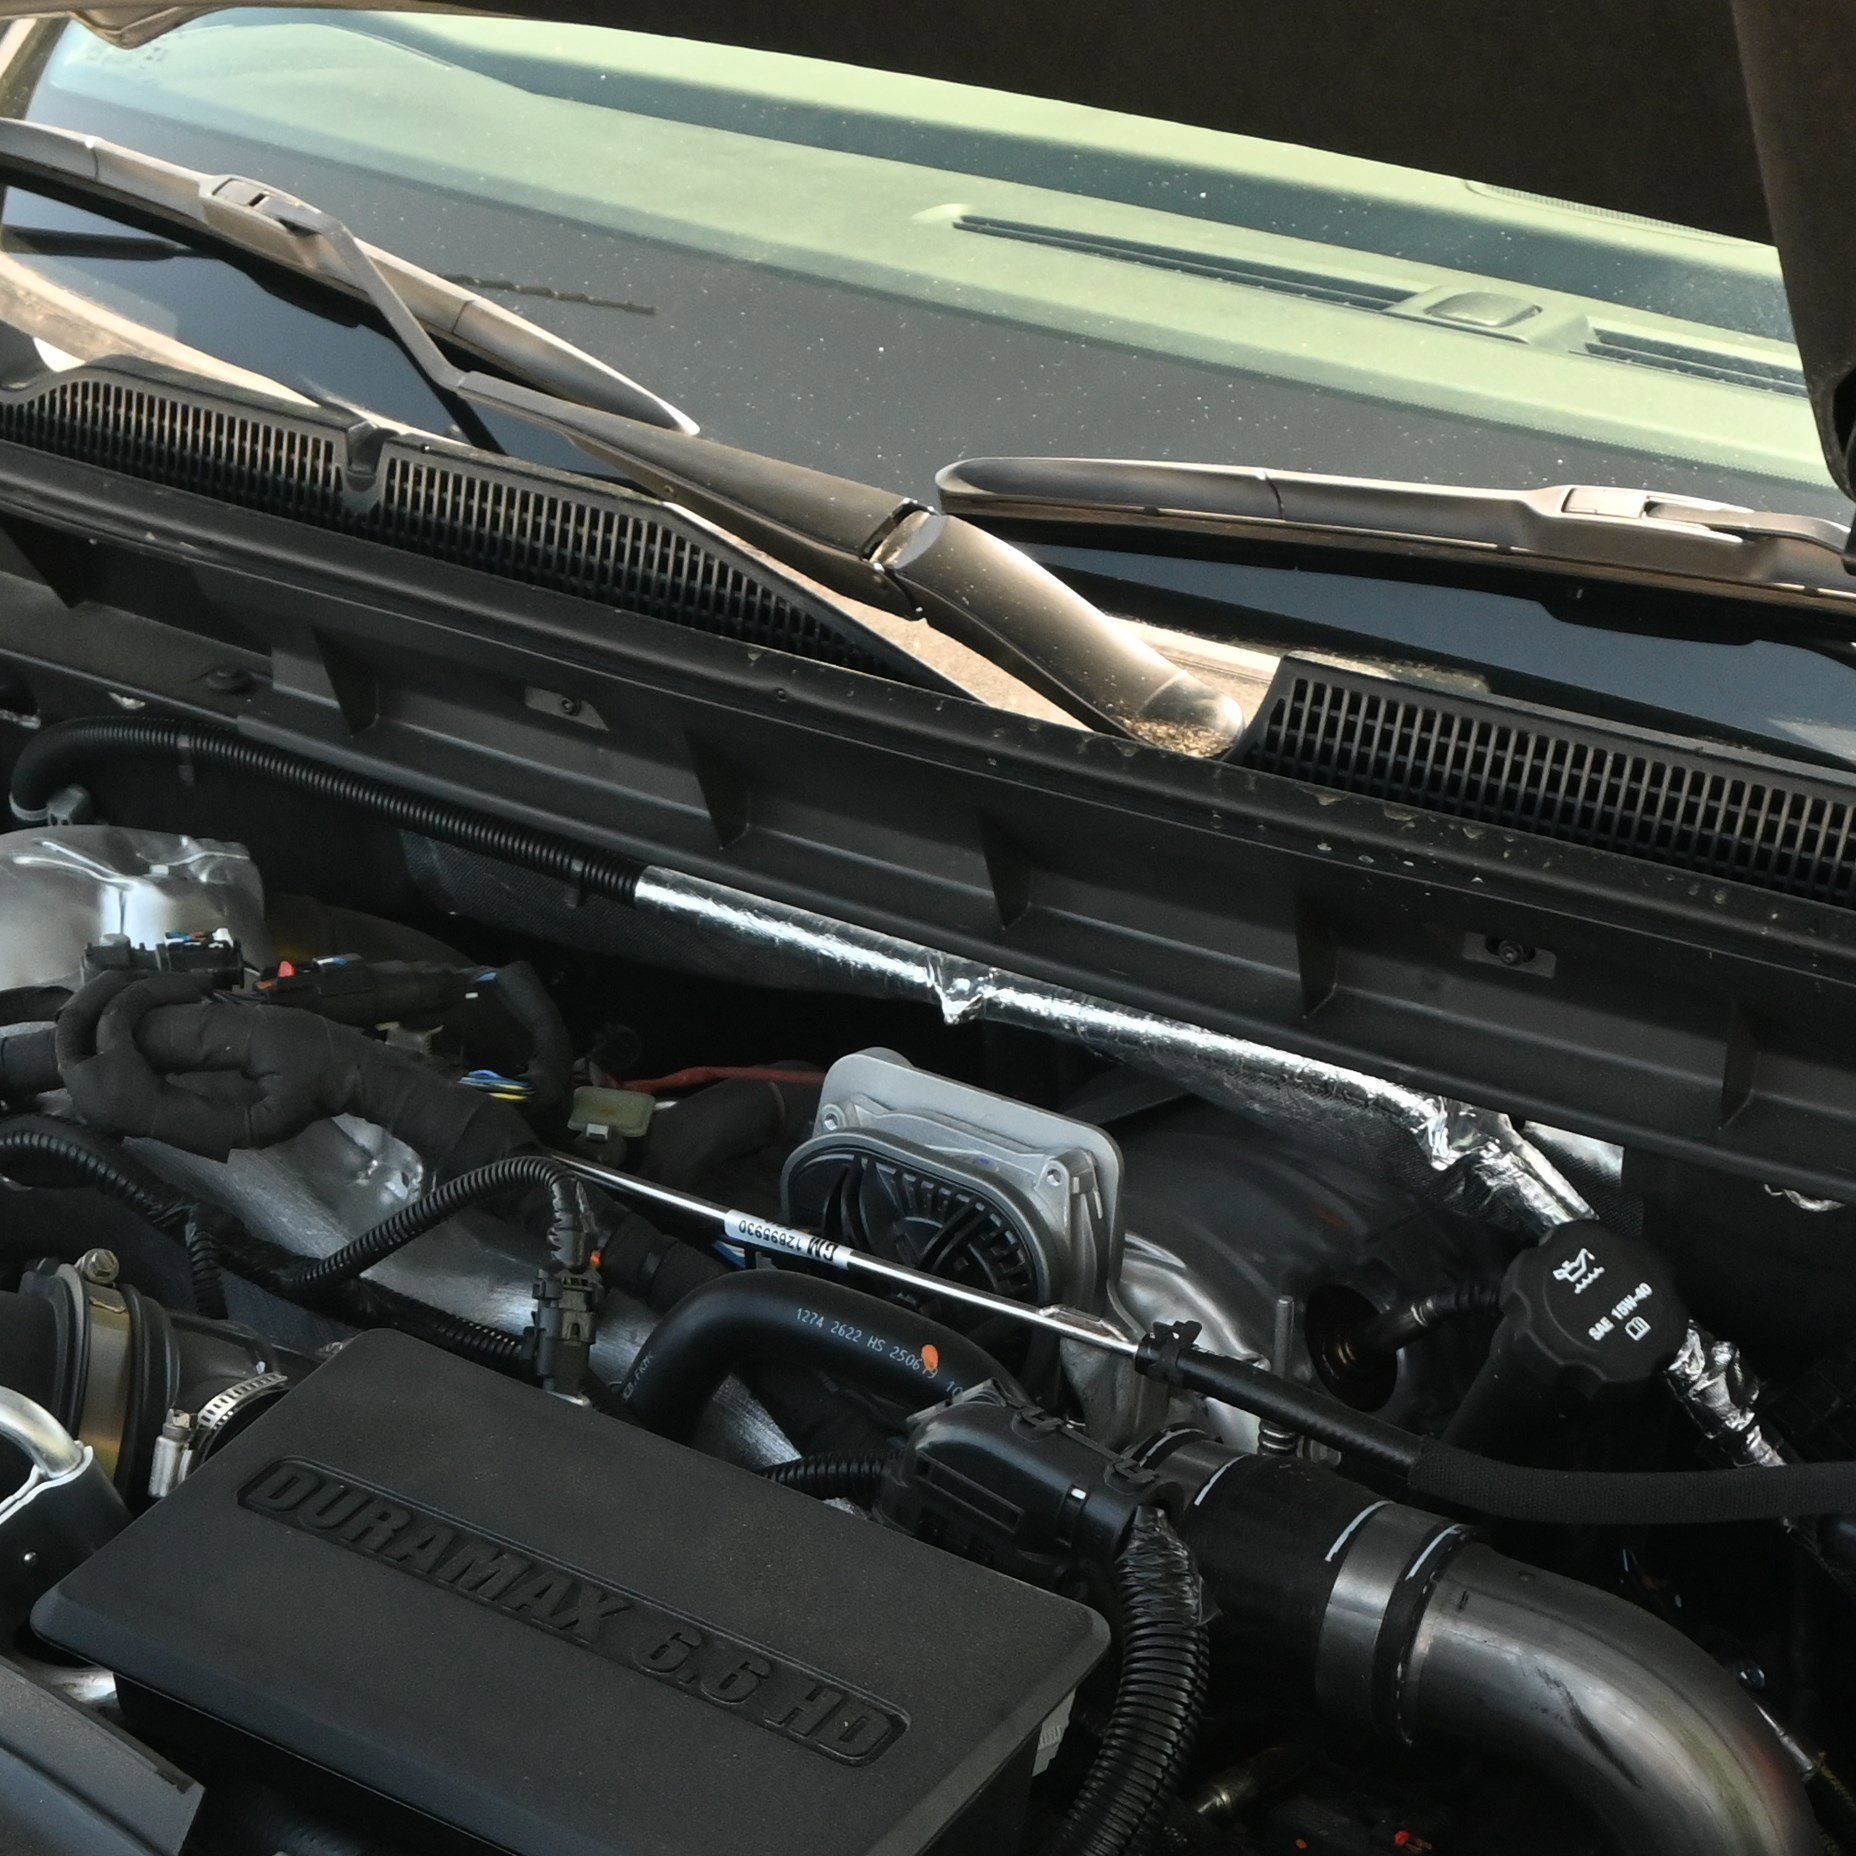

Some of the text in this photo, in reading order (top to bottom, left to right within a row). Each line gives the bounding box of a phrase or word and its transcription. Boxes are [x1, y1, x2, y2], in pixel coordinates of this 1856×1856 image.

[806, 1236, 839, 1262] GM
[795, 1307, 825, 1329] 1274
[829, 1320, 863, 1344] 2622
[866, 1335, 887, 1353] HS
[1588, 1282, 1653, 1341] SAE 15W-40
[257, 1464, 895, 1760] DURAMAX 6.6 HD
